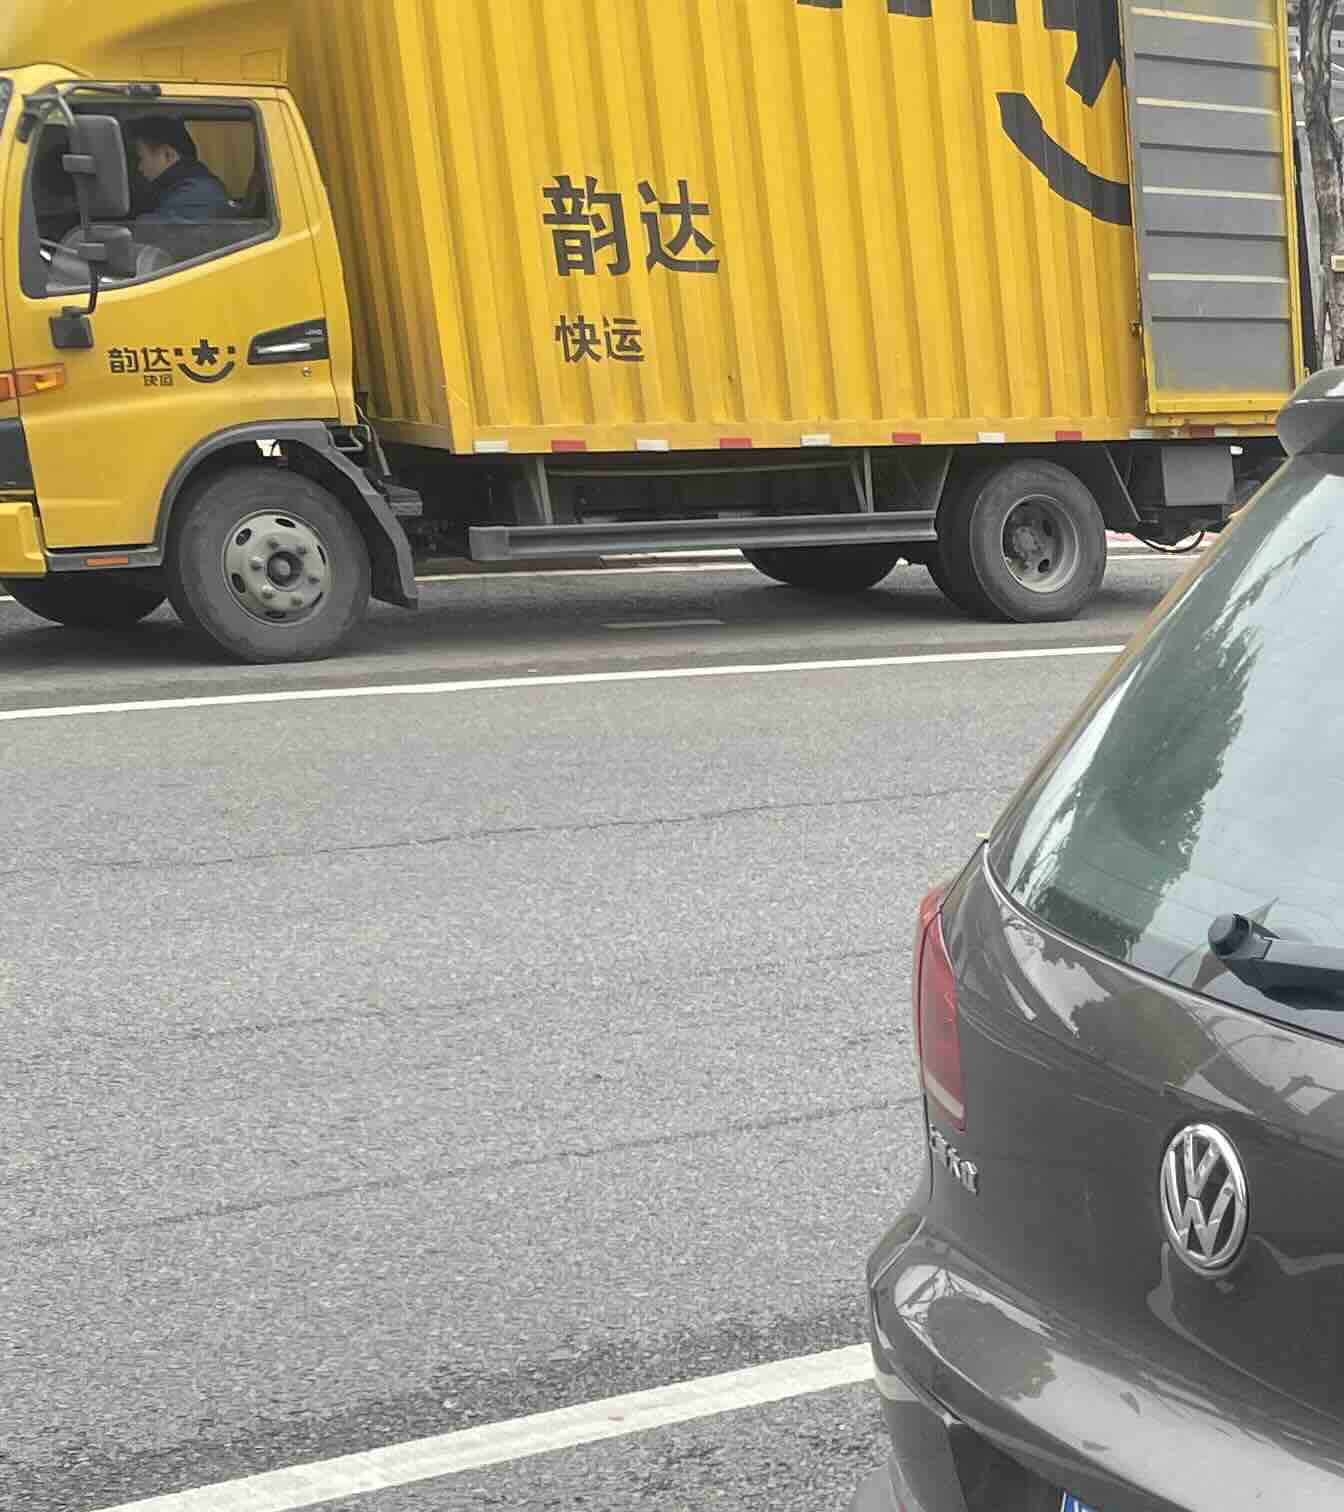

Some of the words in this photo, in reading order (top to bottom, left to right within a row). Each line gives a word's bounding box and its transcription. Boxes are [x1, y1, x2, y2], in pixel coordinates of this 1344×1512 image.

[543, 175, 720, 276] 韵达
[108, 348, 172, 373] 韵达
[554, 314, 646, 363] 快运
